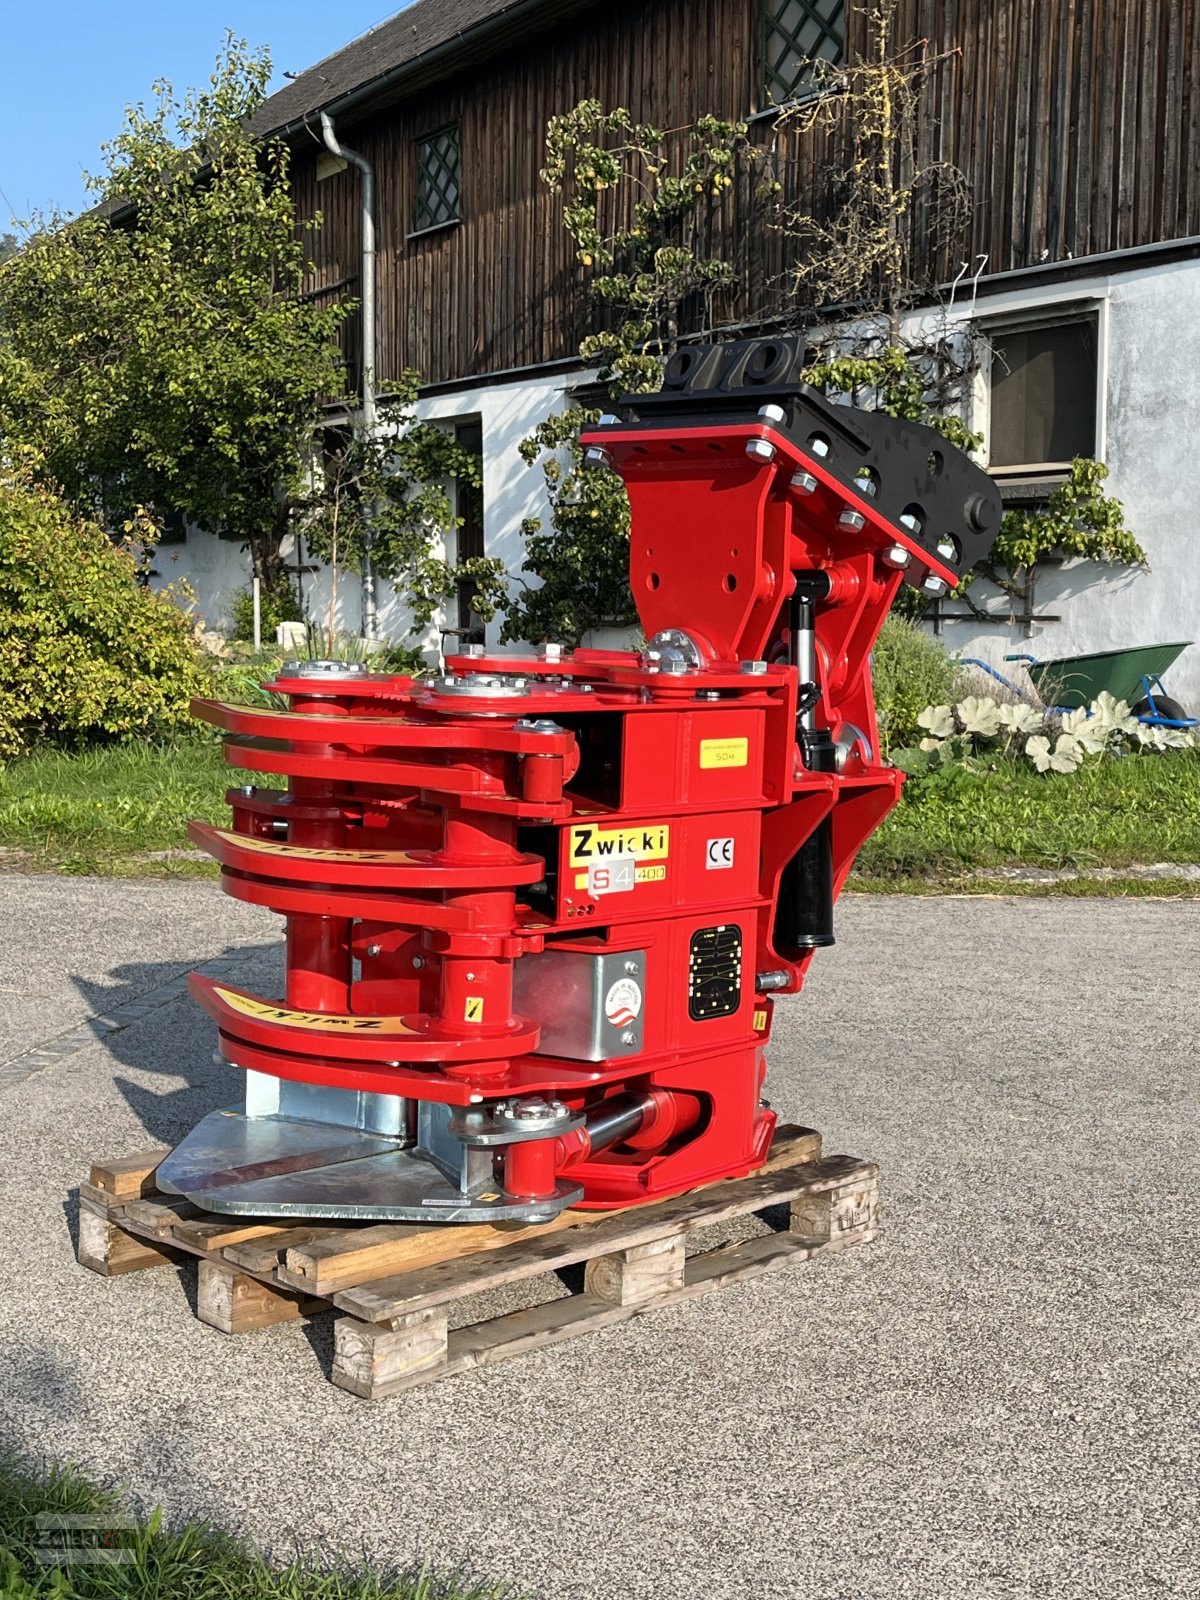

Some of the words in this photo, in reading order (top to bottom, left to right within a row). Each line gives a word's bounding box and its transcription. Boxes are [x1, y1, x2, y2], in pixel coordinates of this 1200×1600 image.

[574, 829, 664, 858] Zwicki
[709, 839, 732, 863] CE
[258, 1009, 384, 1029] Zwicki
